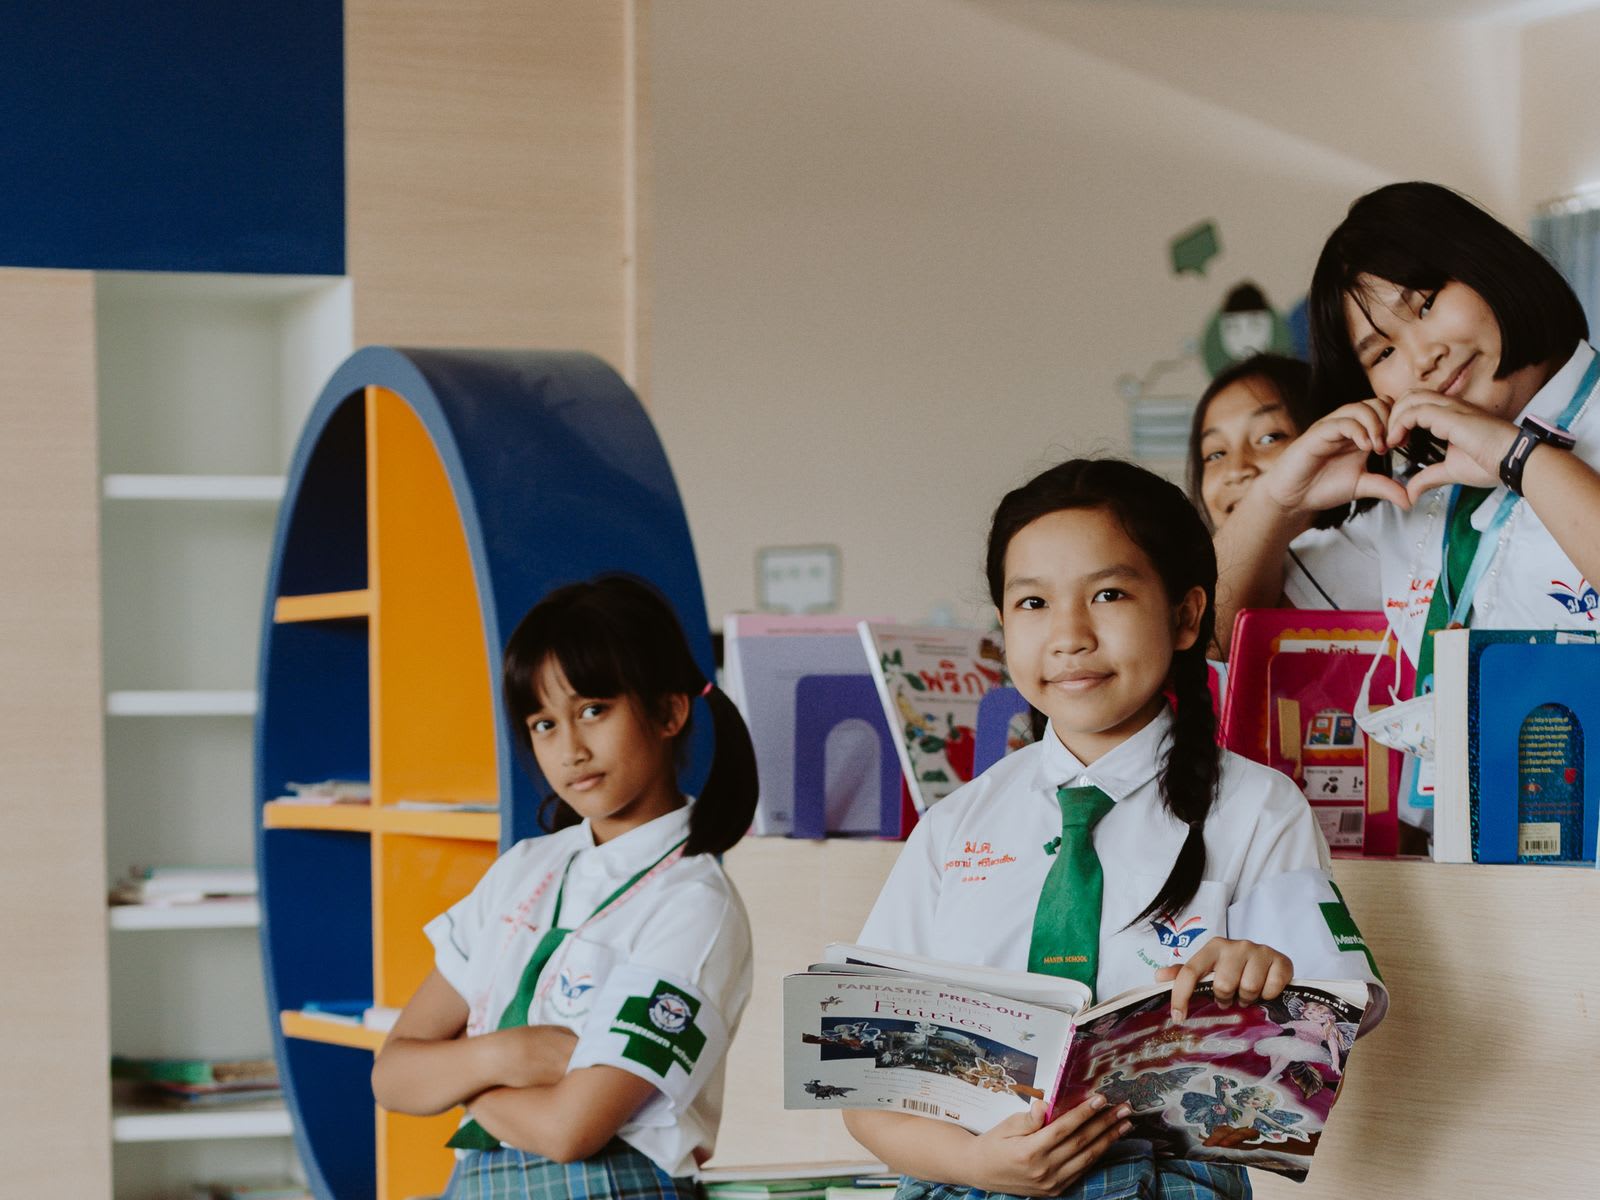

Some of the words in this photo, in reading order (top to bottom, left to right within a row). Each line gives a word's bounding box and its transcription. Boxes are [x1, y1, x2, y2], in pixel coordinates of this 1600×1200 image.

[837, 983, 933, 997] FANTASTIC
[938, 992, 1033, 1021] PRESS-OUT
[873, 1000, 992, 1033] Fairies
[1303, 991, 1350, 1014] Press-out
[1083, 1037, 1245, 1080] Fairies
